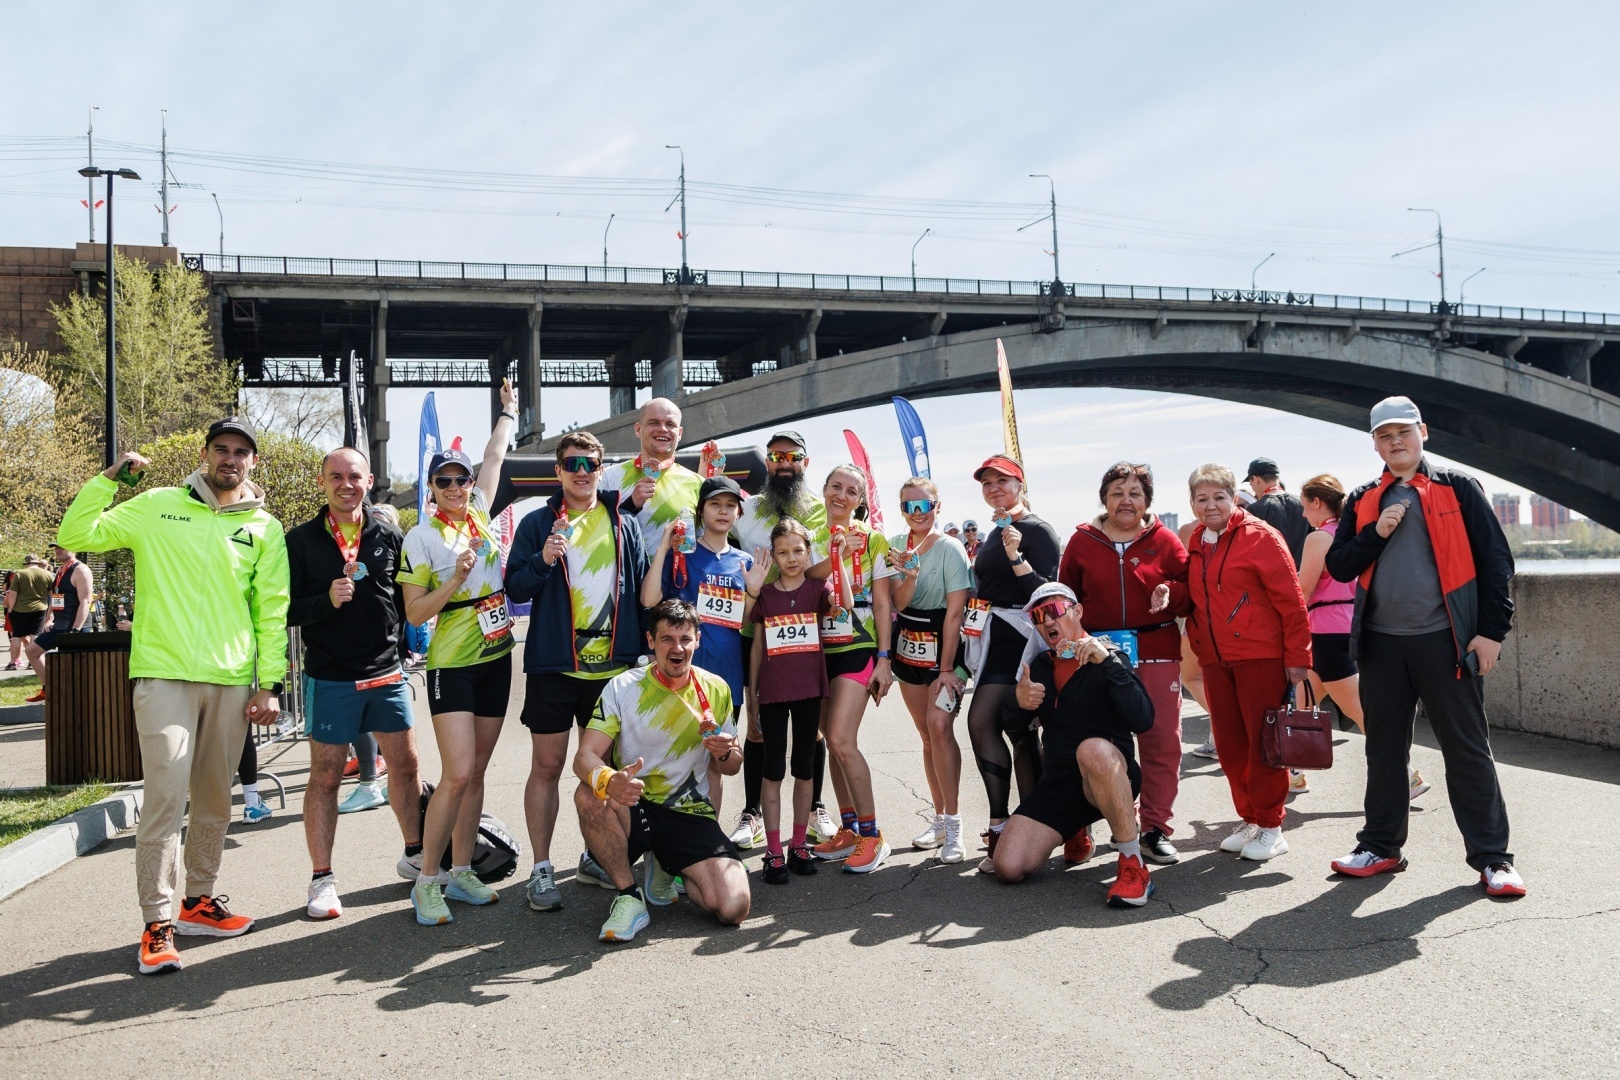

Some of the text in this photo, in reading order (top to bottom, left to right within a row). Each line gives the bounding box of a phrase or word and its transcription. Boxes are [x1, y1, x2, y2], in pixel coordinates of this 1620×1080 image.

[160, 513, 192, 522] KELME
[705, 597, 733, 614] 493
[776, 625, 808, 640] 494
[902, 639, 926, 655] 735
[581, 654, 604, 662] PRO
